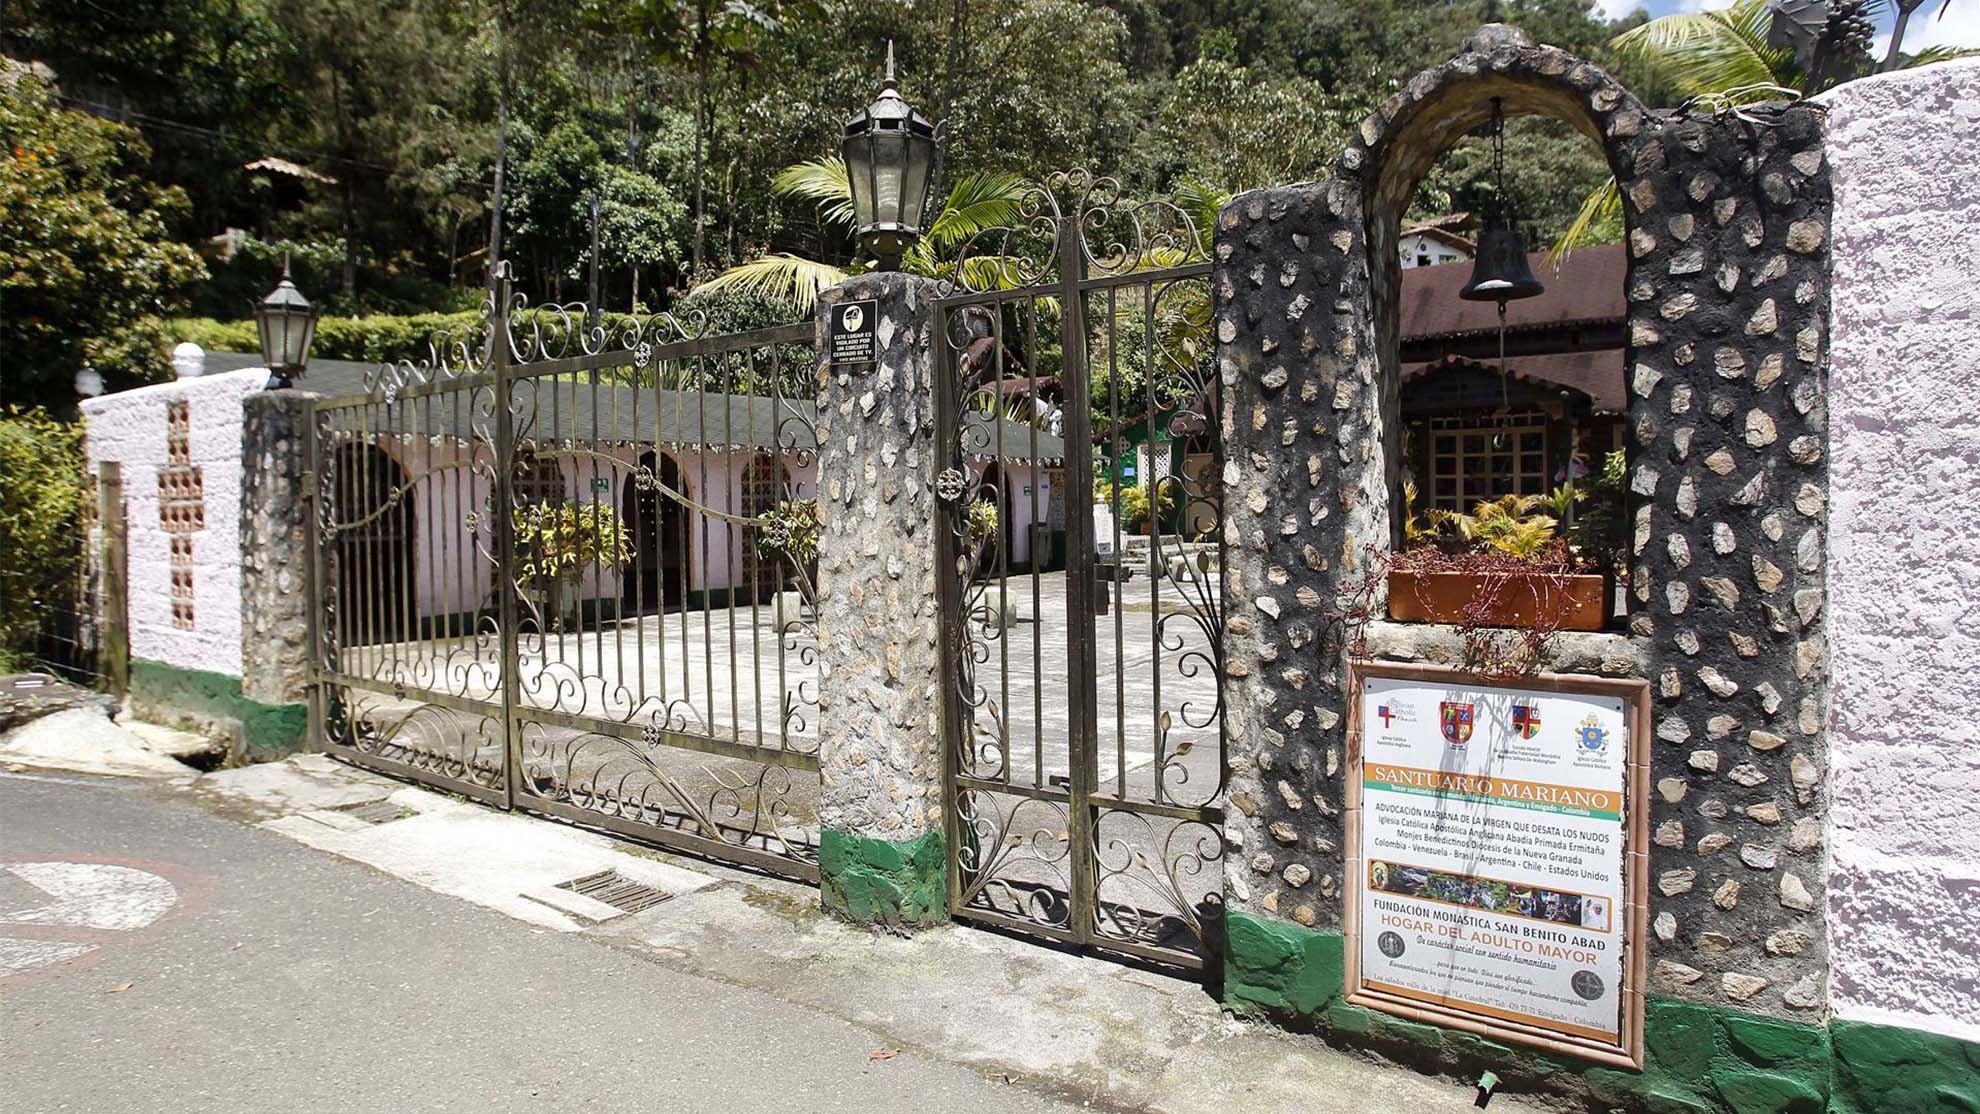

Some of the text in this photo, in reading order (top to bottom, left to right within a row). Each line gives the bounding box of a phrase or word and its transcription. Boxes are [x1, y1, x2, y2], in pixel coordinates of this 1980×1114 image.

[1375, 767, 1608, 809] SANTUARIO MARIANO
[1376, 802, 1610, 844] ADVOCACIÓN MARIANA DE LA VIRGEN QUE DESATA LOS NUDOS
[1378, 815, 1400, 826] Iglesia
[1402, 818, 1428, 830] Católica
[1430, 822, 1468, 836] Apostólica
[1469, 828, 1504, 842] Anglicana
[1534, 838, 1567, 851] Primada
[1568, 842, 1605, 856] Ermitaña
[1374, 837, 1406, 850] Colombia
[1412, 843, 1448, 857] Venezuela
[1454, 849, 1474, 861] Brasil
[1480, 854, 1516, 868] Argentina
[1522, 860, 1542, 872] Chile
[1548, 864, 1579, 878] Estados
[1580, 869, 1609, 882] Unidos
[1396, 829, 1582, 865] Monjes Benedictinos Diócesis de la Nueva Granada
[1374, 899, 1430, 918] FUNDACIÓN
[1495, 921, 1518, 935] SAN
[1523, 927, 1567, 944] BENITO
[1572, 936, 1606, 951] ABAD
[1382, 914, 1598, 966] HOGAR DEL ADULTO MAYOR
[1454, 944, 1475, 954] social
[1488, 950, 1512, 962] sentido
[1514, 954, 1558, 970] humanitario
